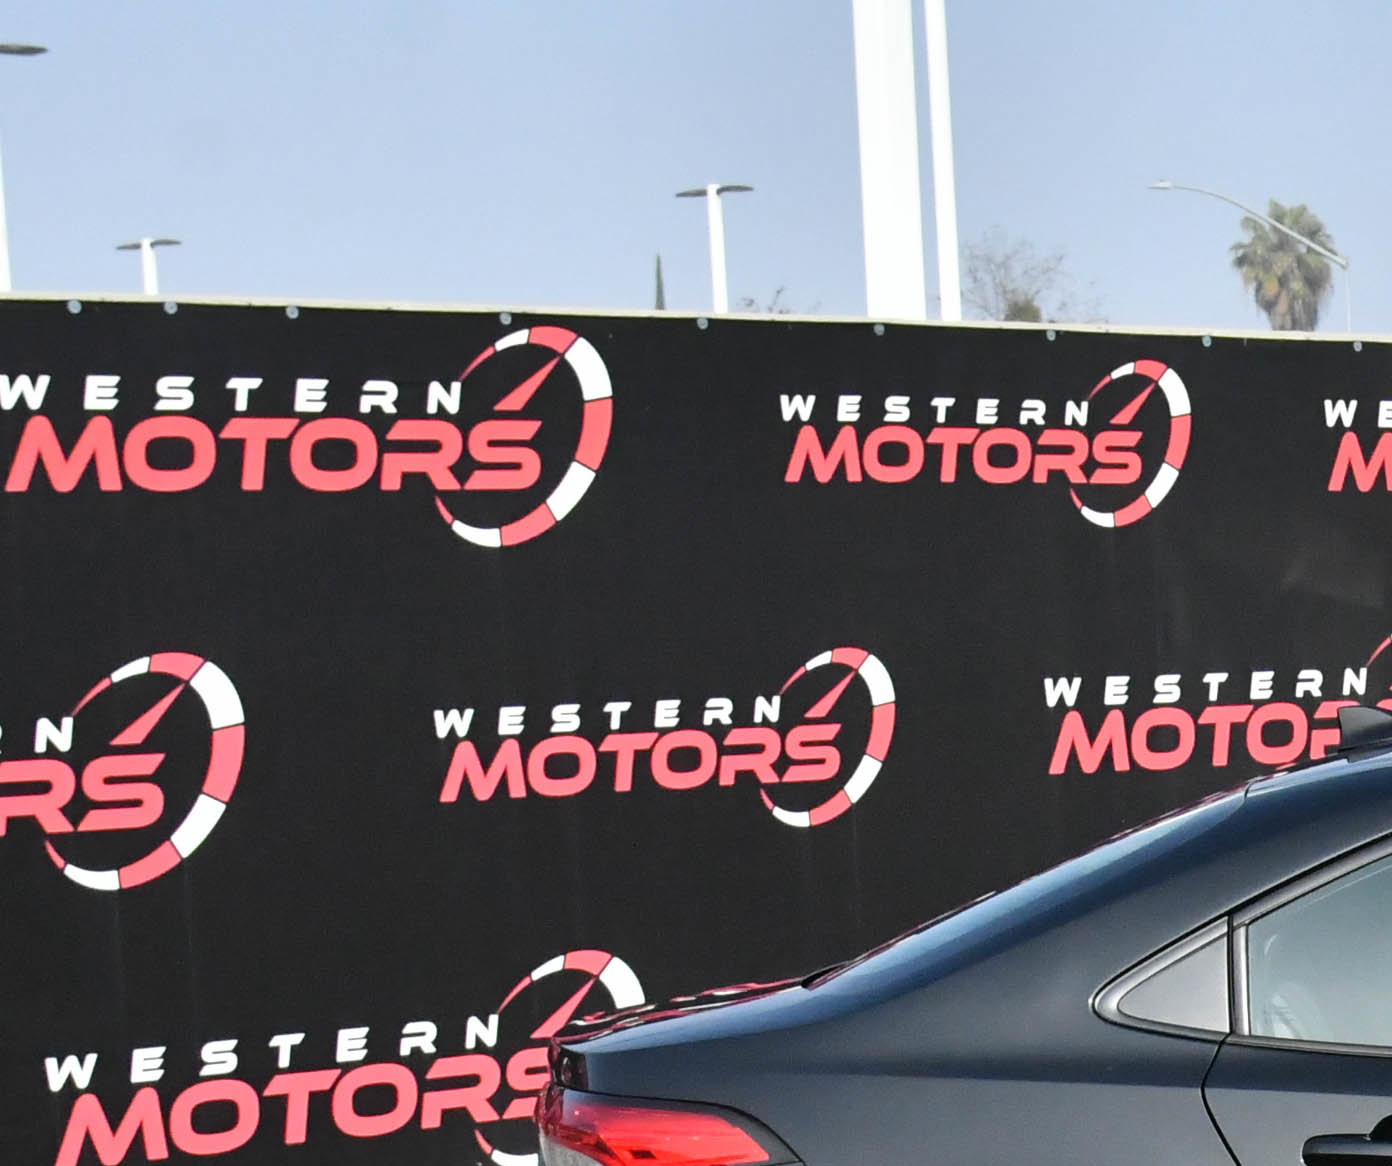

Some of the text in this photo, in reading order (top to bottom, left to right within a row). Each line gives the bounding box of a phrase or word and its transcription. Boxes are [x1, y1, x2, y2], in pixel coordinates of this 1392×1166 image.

[0, 375, 462, 414] WESTERN
[780, 395, 1089, 426] WESTERN
[5, 415, 541, 493] MOTORS
[785, 425, 1143, 484] MOTORS
[434, 696, 781, 738] WESTERN
[1044, 668, 1367, 708] WESTERN
[440, 723, 842, 803] MOTORS
[0, 752, 166, 837] RS
[45, 1014, 499, 1093] WESTERN
